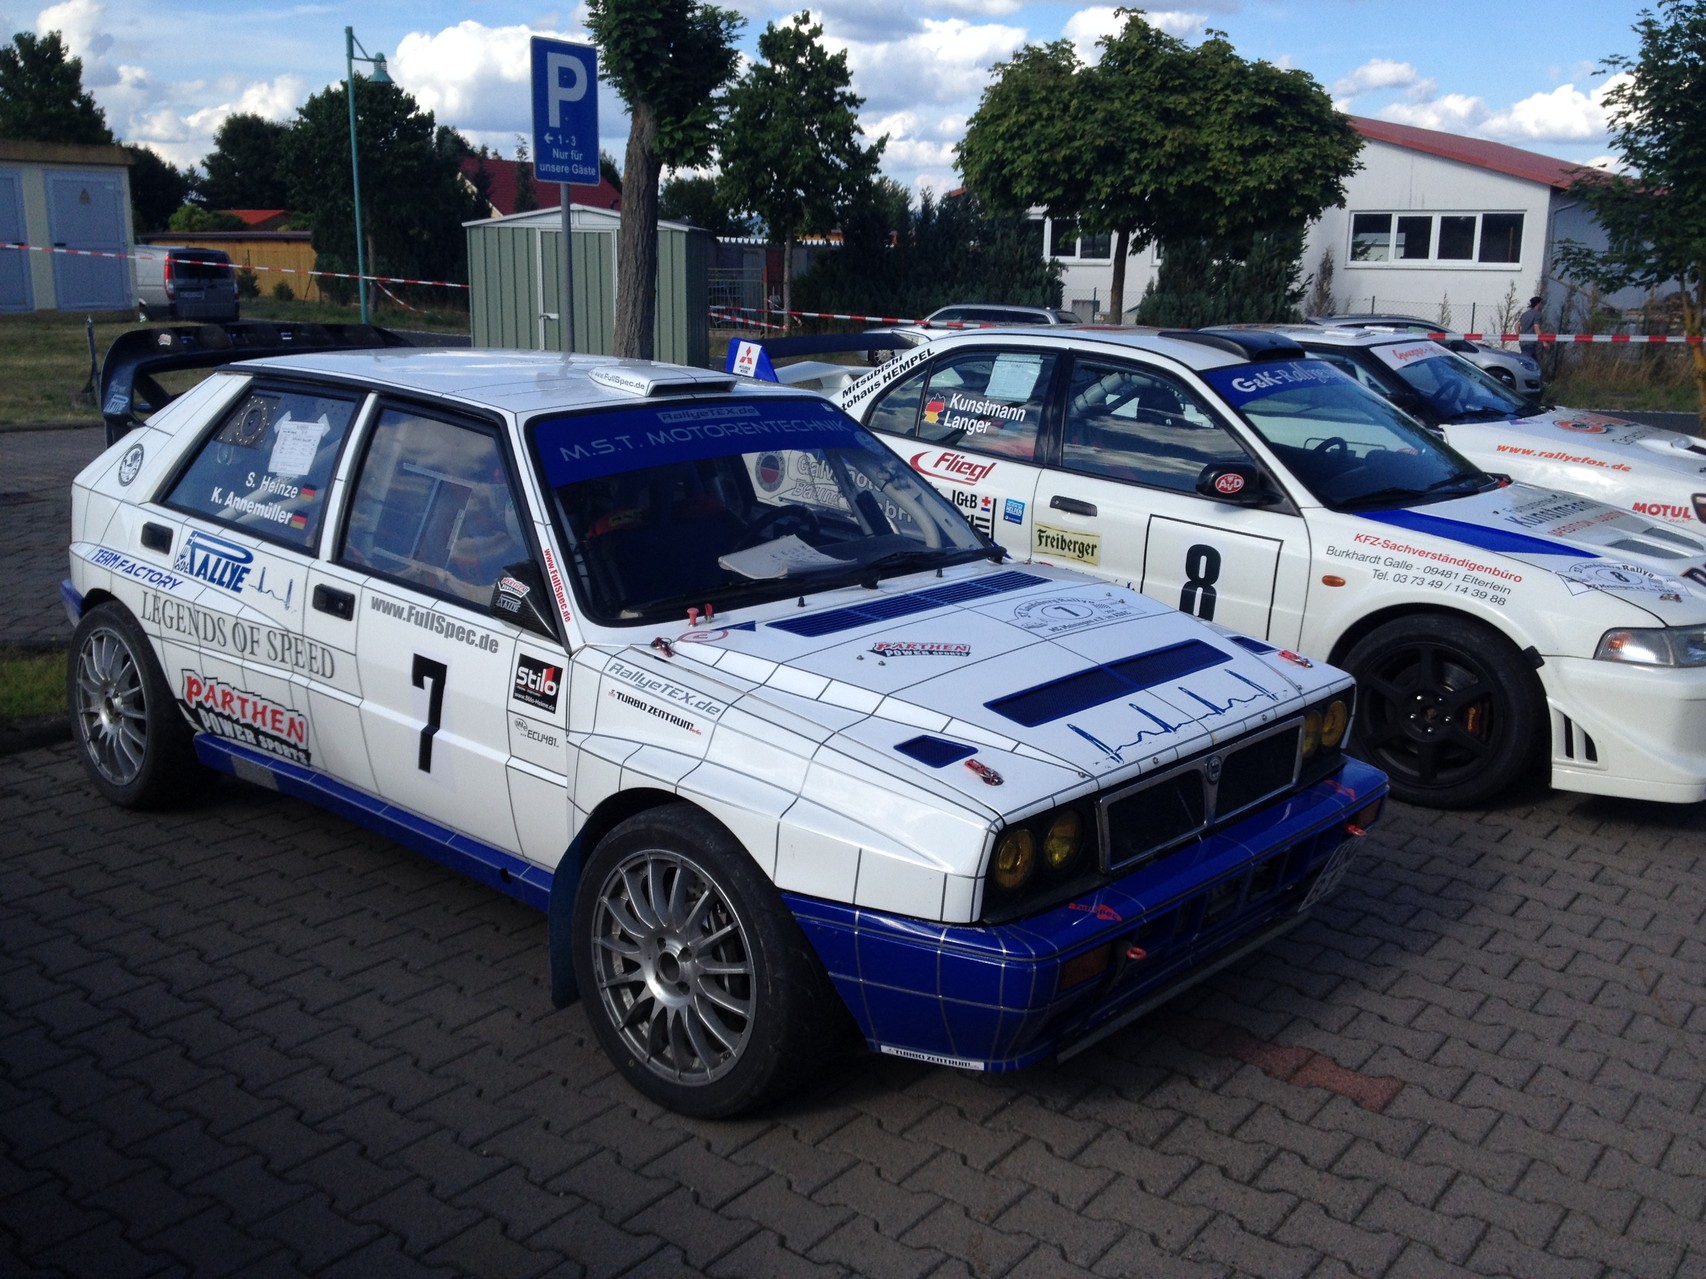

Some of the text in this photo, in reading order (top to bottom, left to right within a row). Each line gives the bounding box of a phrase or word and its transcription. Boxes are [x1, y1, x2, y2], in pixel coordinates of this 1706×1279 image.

[547, 52, 588, 128] P
[552, 149, 583, 161] Nur für
[570, 136, 576, 146] 3
[539, 163, 596, 176] unsere Gäste
[842, 355, 902, 398] Mitsubishi
[882, 348, 935, 383] HEMPEL
[943, 411, 991, 435] Langer
[949, 393, 1026, 422] Kunstmann
[559, 418, 848, 463] M.S.T. MOTORENTECHNIK
[1496, 444, 1631, 472] www.rallyefox.de
[245, 471, 298, 499] S. Heinze
[932, 451, 997, 481] Fliegl
[211, 486, 293, 525] K. Annemüller
[1632, 502, 1692, 519] MOTUL
[1036, 528, 1097, 558] Freiberger
[1353, 533, 1522, 583] KFZ-Sachverständigenbüro
[91, 549, 119, 568] TEAM
[118, 552, 183, 590] FACTORY
[543, 548, 571, 623] www.FullSpec.de
[1179, 543, 1222, 622] 8
[1325, 545, 1382, 565] Burkhardt
[1383, 556, 1413, 571] Galle
[1423, 565, 1459, 581] 09481
[1461, 574, 1512, 595] Elterlein
[1372, 568, 1389, 582] Tel.
[1392, 573, 1407, 584] 03
[1410, 575, 1425, 586] 73
[1427, 578, 1443, 589] 49
[1454, 584, 1469, 595] 14
[1470, 588, 1487, 600] 39
[1489, 594, 1507, 606] 88
[140, 590, 335, 679] LEGENDS OF SPEED
[371, 596, 499, 654] www.FullSpec.de
[876, 643, 968, 652] PARTHEN
[516, 666, 557, 696] Stilo
[608, 662, 721, 716] RallyeTEX.de
[186, 675, 305, 743] PARTHEN
[412, 653, 448, 774] 7
[616, 691, 647, 711] TURBO
[647, 705, 694, 731] ZENTRUM
[200, 708, 311, 766] POWER SPORTS
